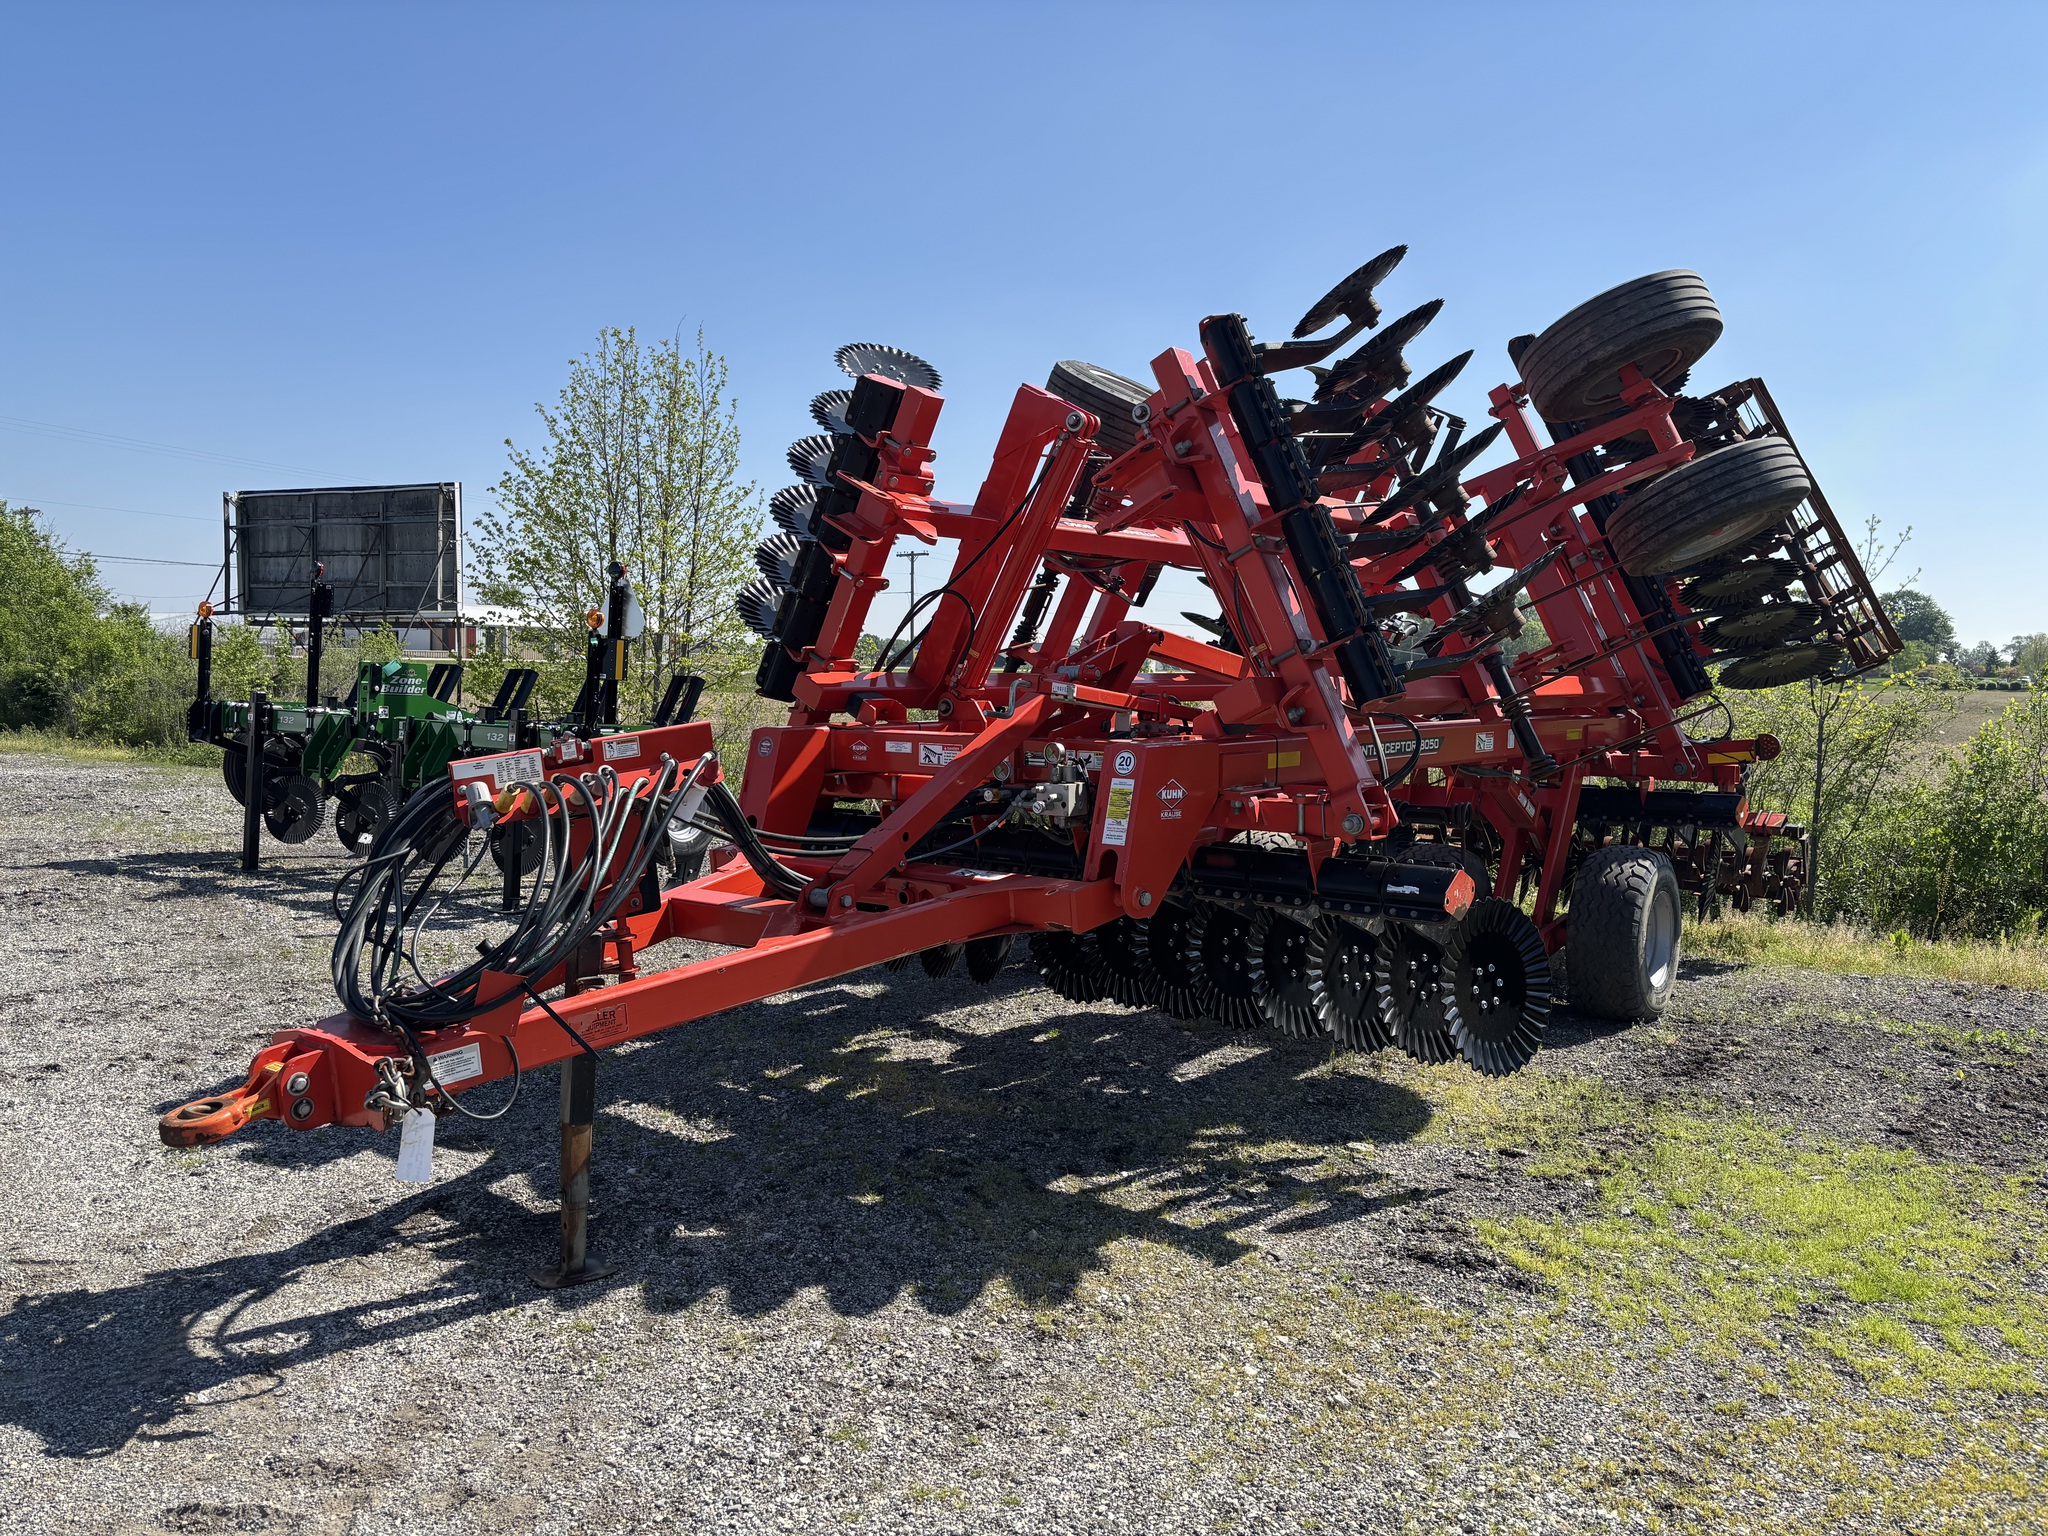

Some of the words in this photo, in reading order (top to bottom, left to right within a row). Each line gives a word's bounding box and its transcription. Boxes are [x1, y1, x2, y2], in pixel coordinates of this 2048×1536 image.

[390, 676, 422, 685] Zone
[381, 684, 426, 694] Builder
[280, 716, 294, 724] 132
[487, 733, 504, 742] 132
[1420, 738, 1440, 750] 8050
[1118, 756, 1132, 766] 20
[1161, 789, 1183, 800] KUHN
[438, 1050, 463, 1060] WARNING
